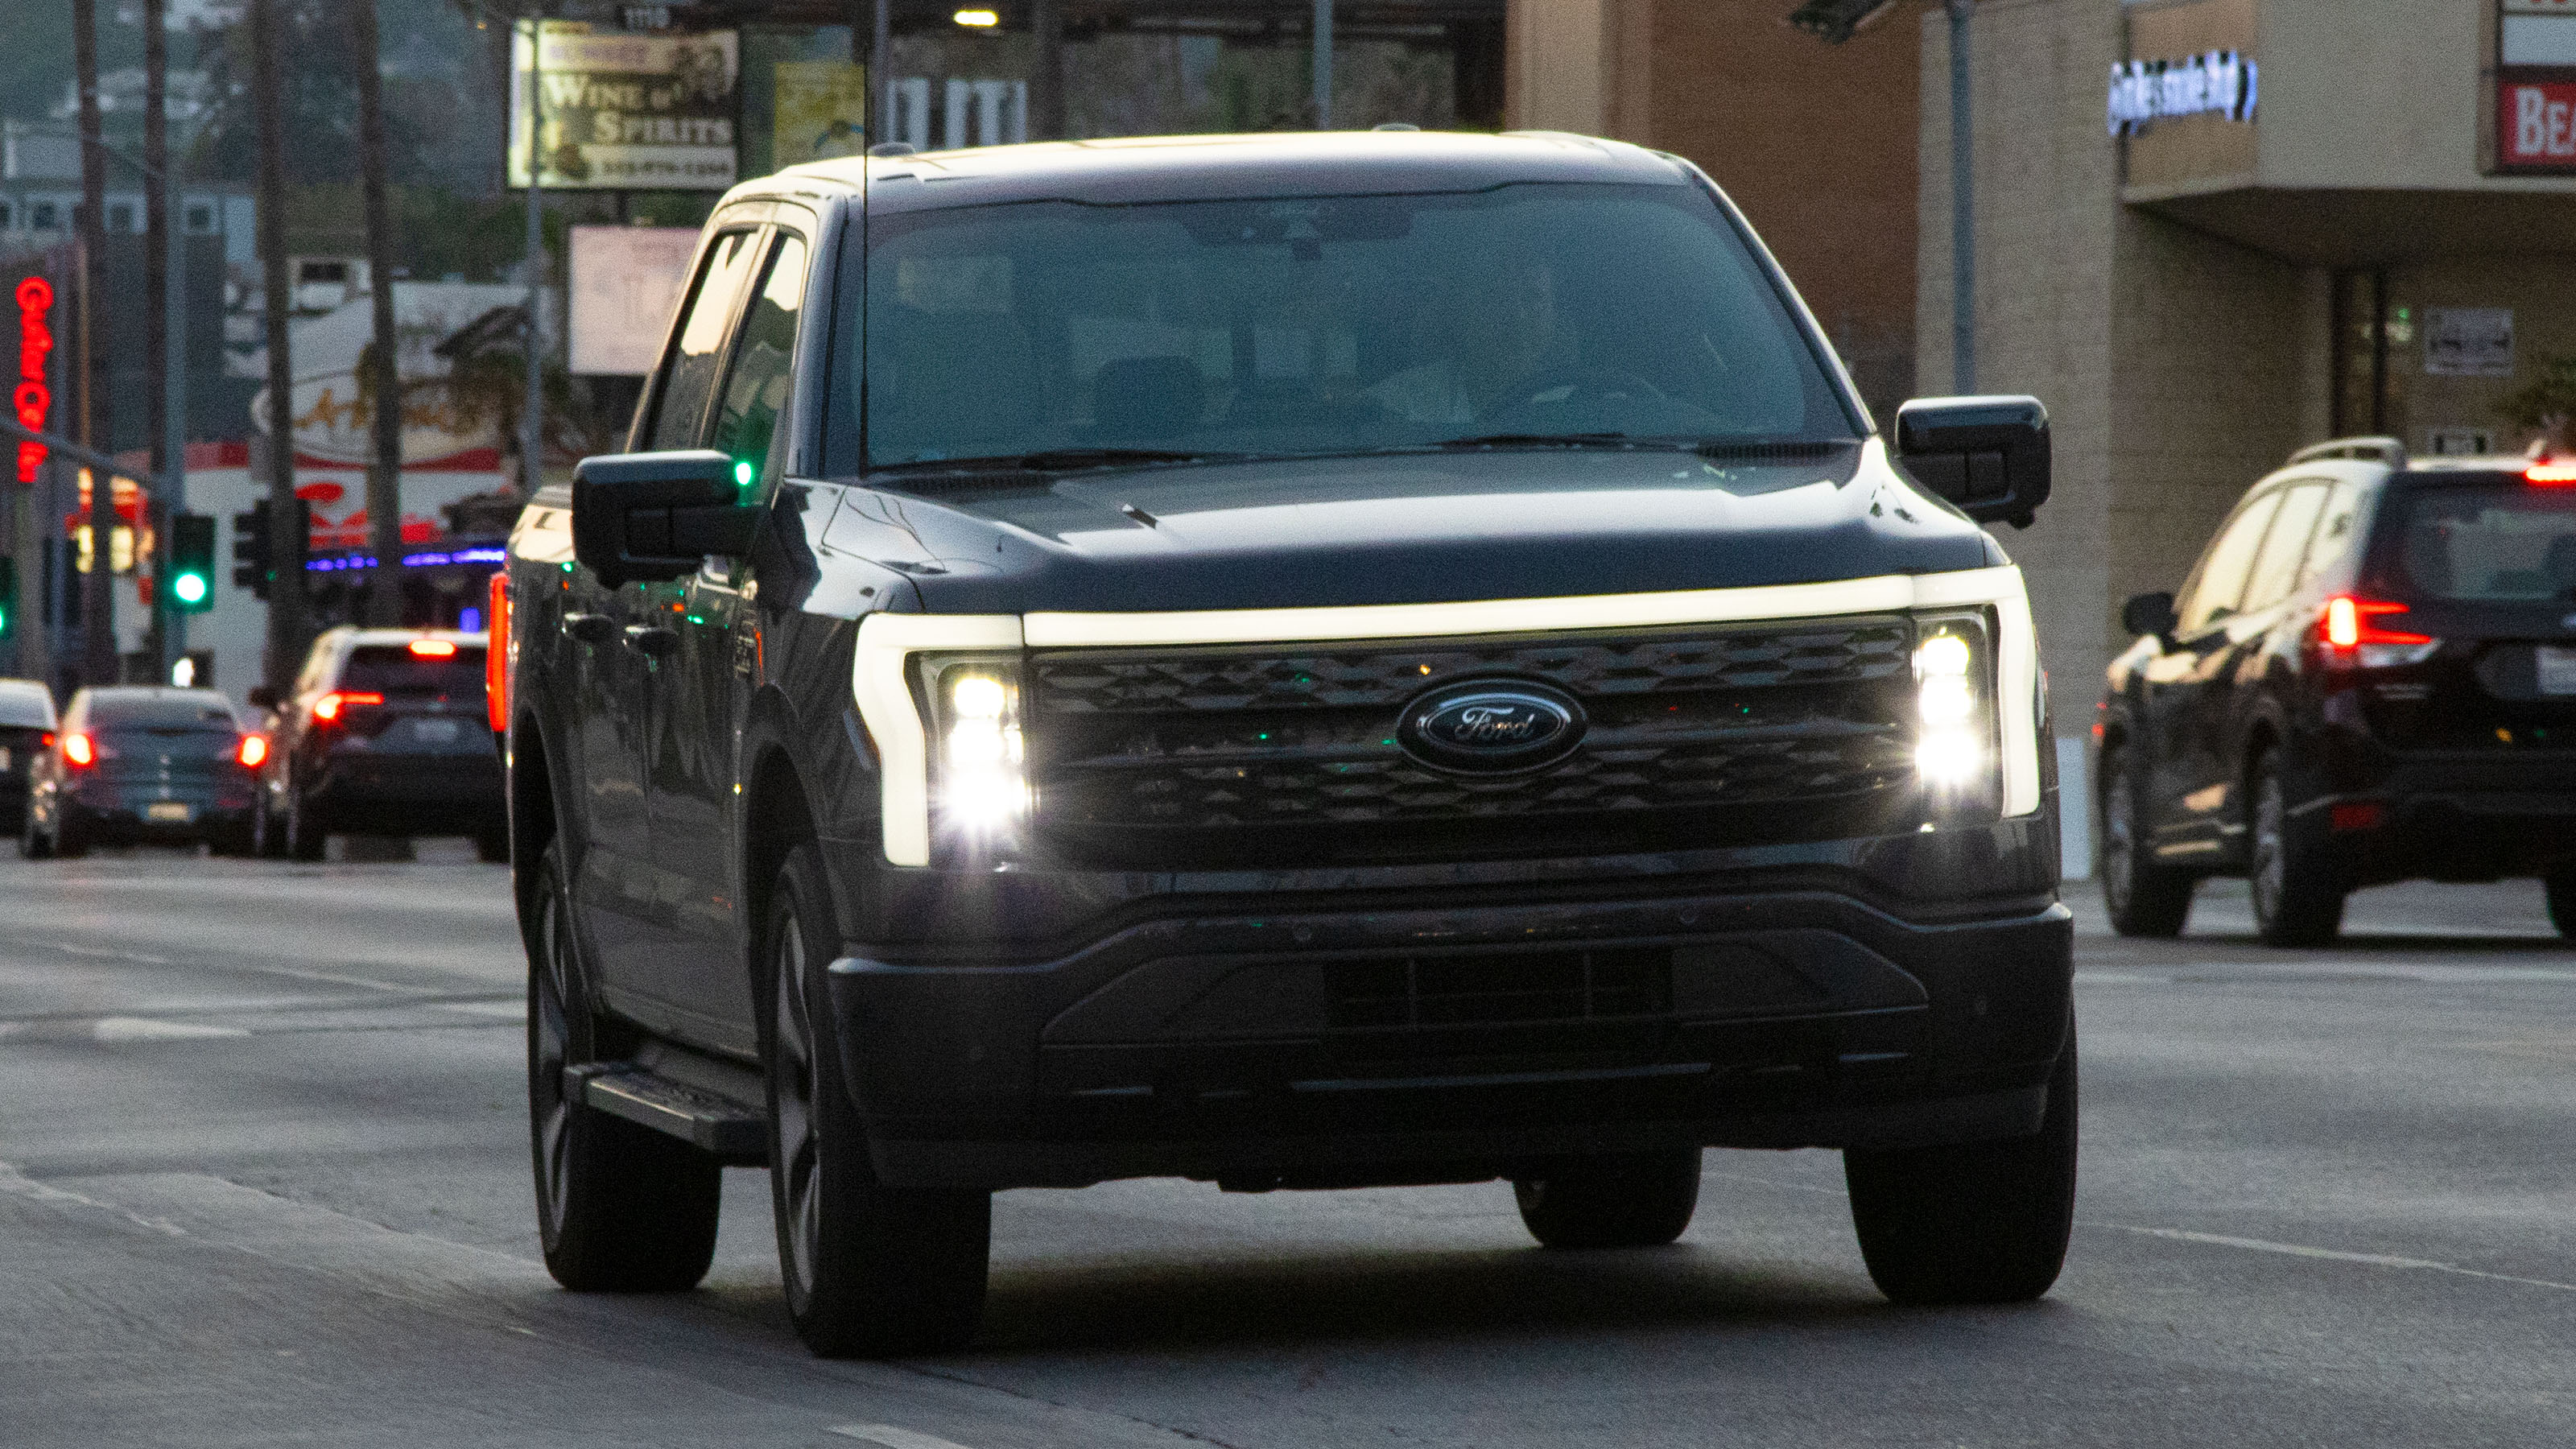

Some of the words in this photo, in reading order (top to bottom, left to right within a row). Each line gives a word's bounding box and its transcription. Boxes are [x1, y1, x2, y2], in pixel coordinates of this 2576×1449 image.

[592, 110, 733, 143] SPIRITS
[2516, 86, 2576, 155] BE
[1455, 707, 1535, 739] Ford
